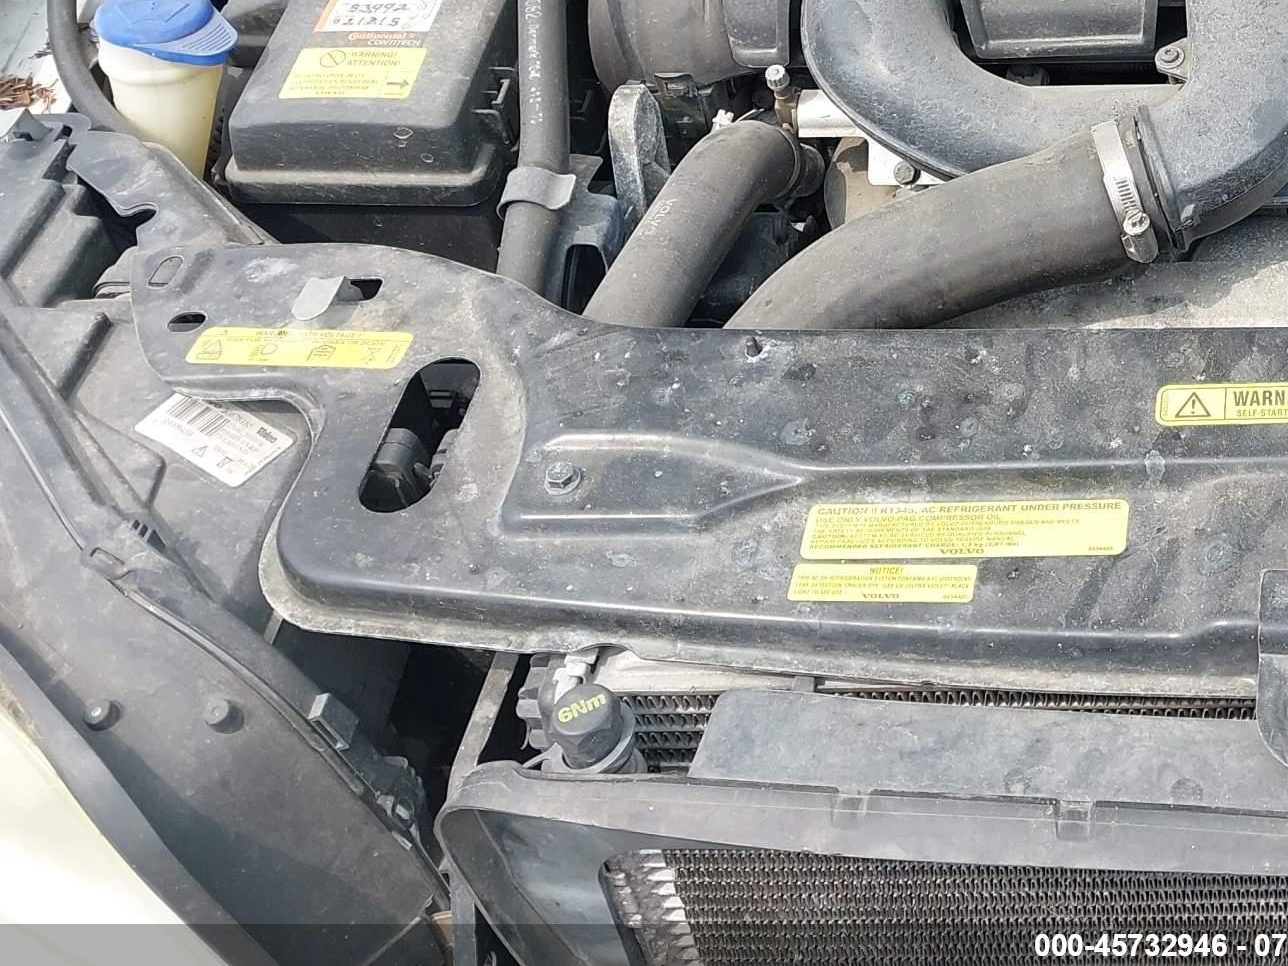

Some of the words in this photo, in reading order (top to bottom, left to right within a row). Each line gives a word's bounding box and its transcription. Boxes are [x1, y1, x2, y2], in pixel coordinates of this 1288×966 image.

[818, 507, 869, 515] CAUTION
[921, 506, 938, 514] AC
[939, 504, 1017, 513] REFRIGERANT
[1020, 503, 1059, 512] UNDER
[1062, 502, 1122, 511] PRESSURE
[918, 513, 984, 522] COMPRESSOR
[869, 566, 905, 575] NOTICE!
[557, 693, 607, 724] 6Nm
